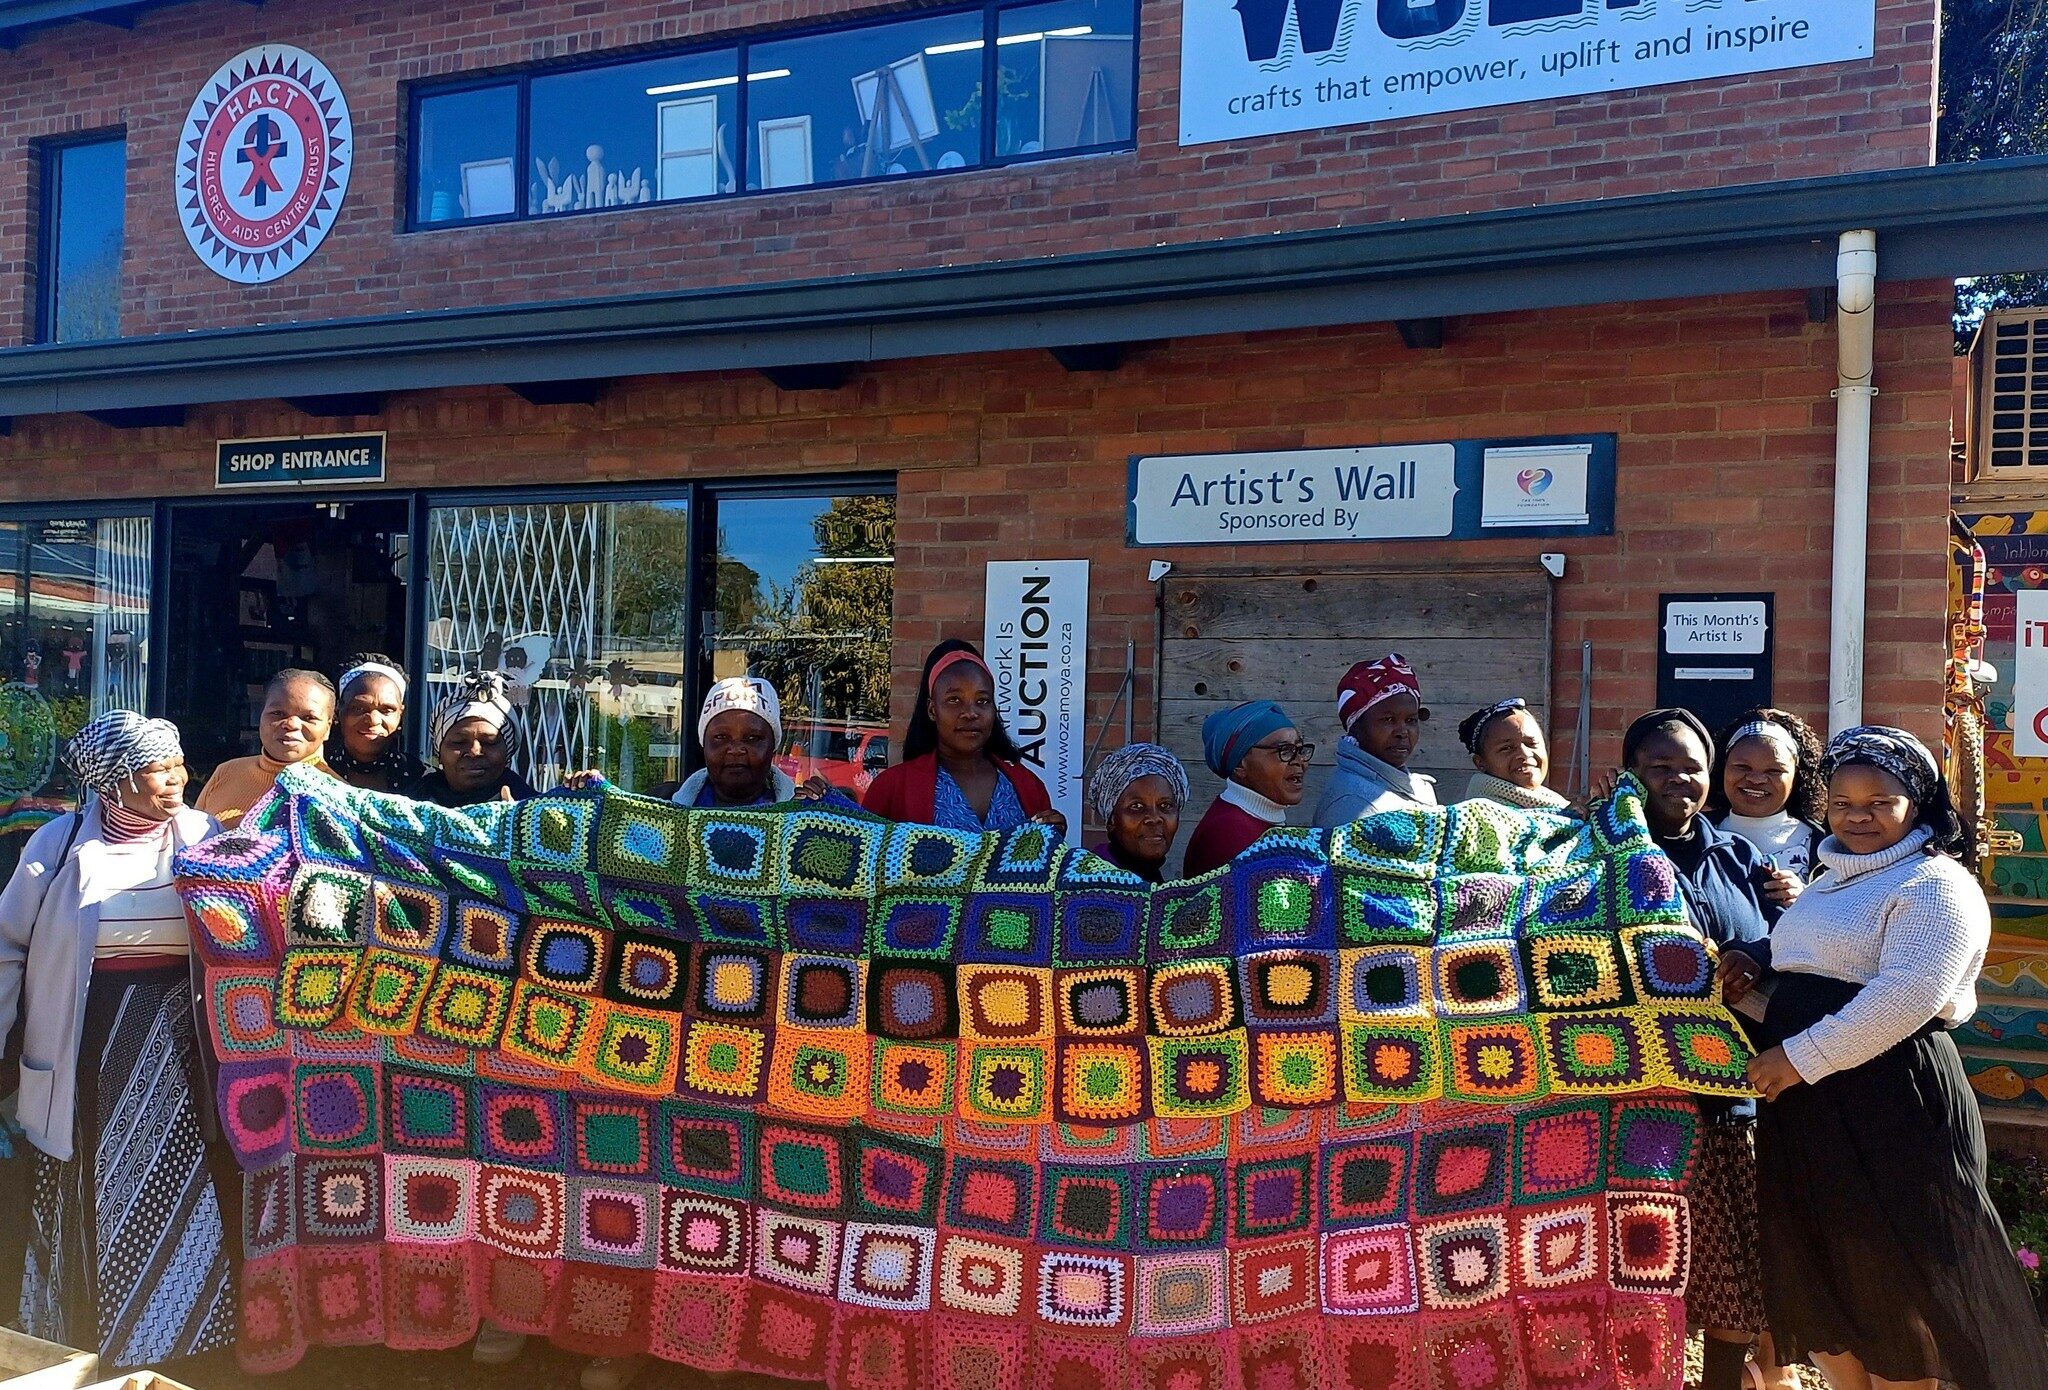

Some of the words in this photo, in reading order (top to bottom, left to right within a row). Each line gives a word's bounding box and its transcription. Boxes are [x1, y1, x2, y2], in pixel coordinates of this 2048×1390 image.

[1227, 85, 1302, 115] crafts
[1314, 75, 1371, 103] that
[1383, 58, 1527, 95] empower,
[1540, 39, 1621, 77] uplift
[1634, 28, 1692, 61] and
[1706, 16, 1810, 52] inspire
[226, 83, 299, 122] HACT
[205, 151, 231, 227] HILLCREST
[232, 224, 260, 242] AIDS
[265, 192, 310, 239] CENTRE
[305, 136, 320, 187] TRUST
[230, 453, 275, 472] SHOP
[282, 448, 370, 470] ENTRANCE
[1170, 468, 1315, 507] Artist's
[1334, 460, 1417, 502] Wall
[1219, 508, 1325, 533] Sponsored
[1334, 508, 1360, 531] By
[995, 622, 1013, 639] Is
[1673, 613, 1698, 626] This
[1704, 613, 1759, 626] Month's
[1688, 630, 1728, 642] Artist
[1733, 630, 1743, 642] Is
[1018, 576, 1051, 769] AUCTION
[1057, 622, 1073, 799] www.wozamoya.co.za
